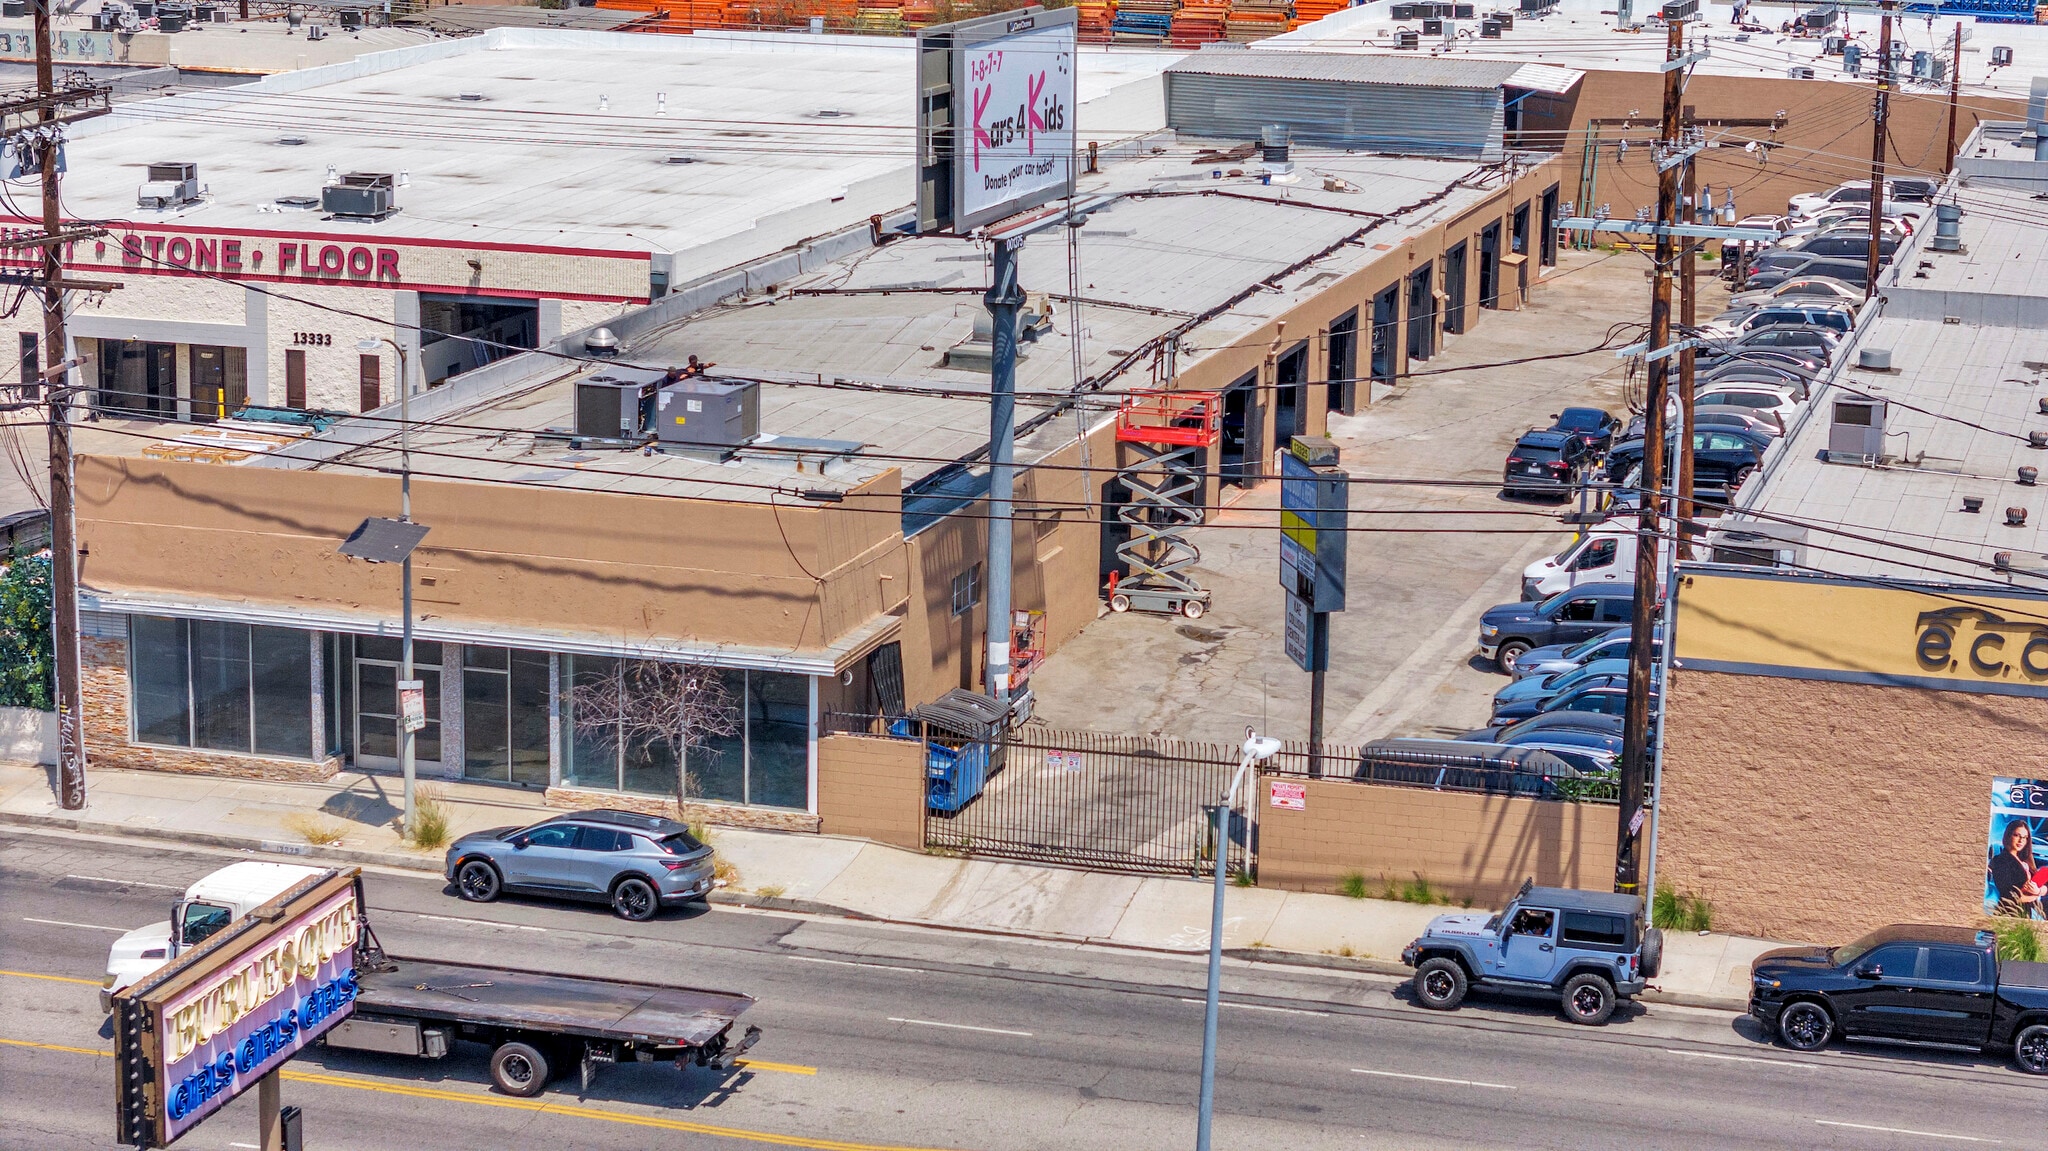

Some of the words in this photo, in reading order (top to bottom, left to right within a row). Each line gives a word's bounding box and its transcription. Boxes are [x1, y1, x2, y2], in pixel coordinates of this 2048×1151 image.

[971, 50, 1003, 82] 1-8-7-7
[973, 83, 1014, 173] Kars
[1016, 103, 1026, 139] 4
[1028, 70, 1064, 157] Kids
[984, 173, 1008, 191] Donate
[1008, 164, 1023, 187] your
[1024, 163, 1035, 176] car
[122, 233, 243, 269] STONE
[278, 242, 401, 279] FLOOR
[293, 332, 332, 346] 13333
[165, 896, 358, 1065] BURLESQUE
[167, 1050, 235, 1121] GIRLS
[235, 1008, 299, 1074] GIRLS
[297, 967, 359, 1031] GIRLS
